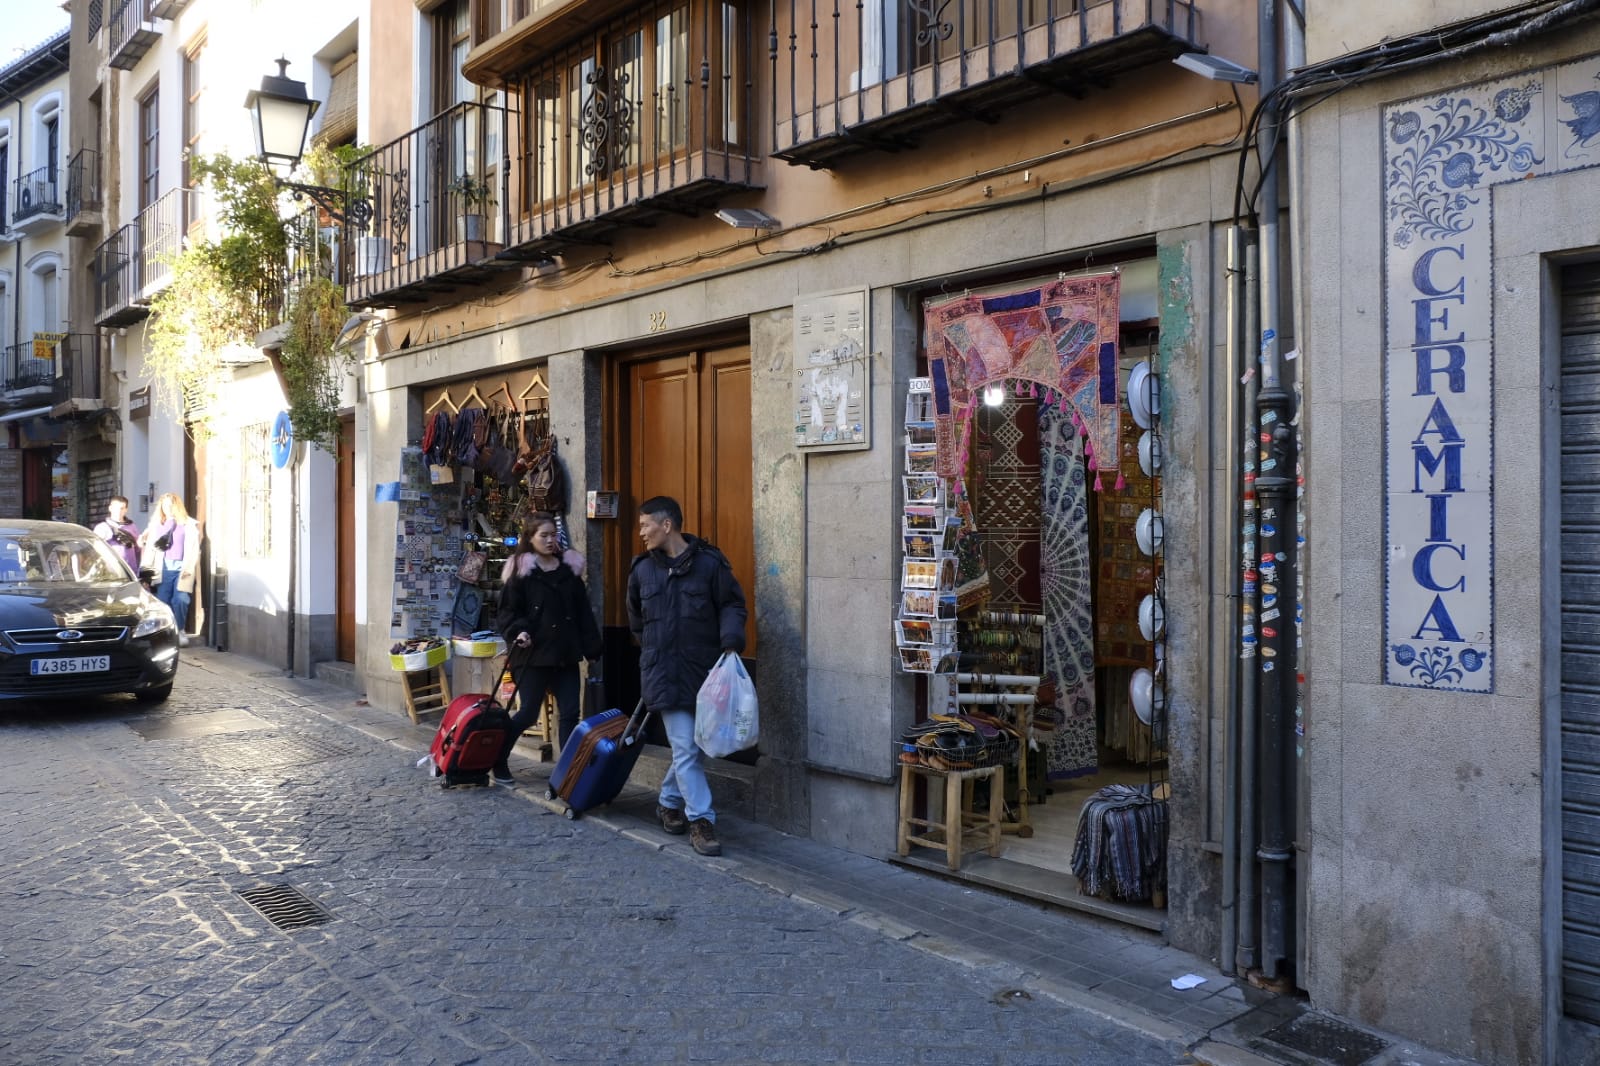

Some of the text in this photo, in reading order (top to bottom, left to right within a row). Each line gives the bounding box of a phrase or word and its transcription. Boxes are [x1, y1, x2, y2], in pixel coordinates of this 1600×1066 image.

[649, 311, 667, 331] 32
[1411, 244, 1466, 642] CERAMICA
[41, 658, 107, 672] 4385 HYS
